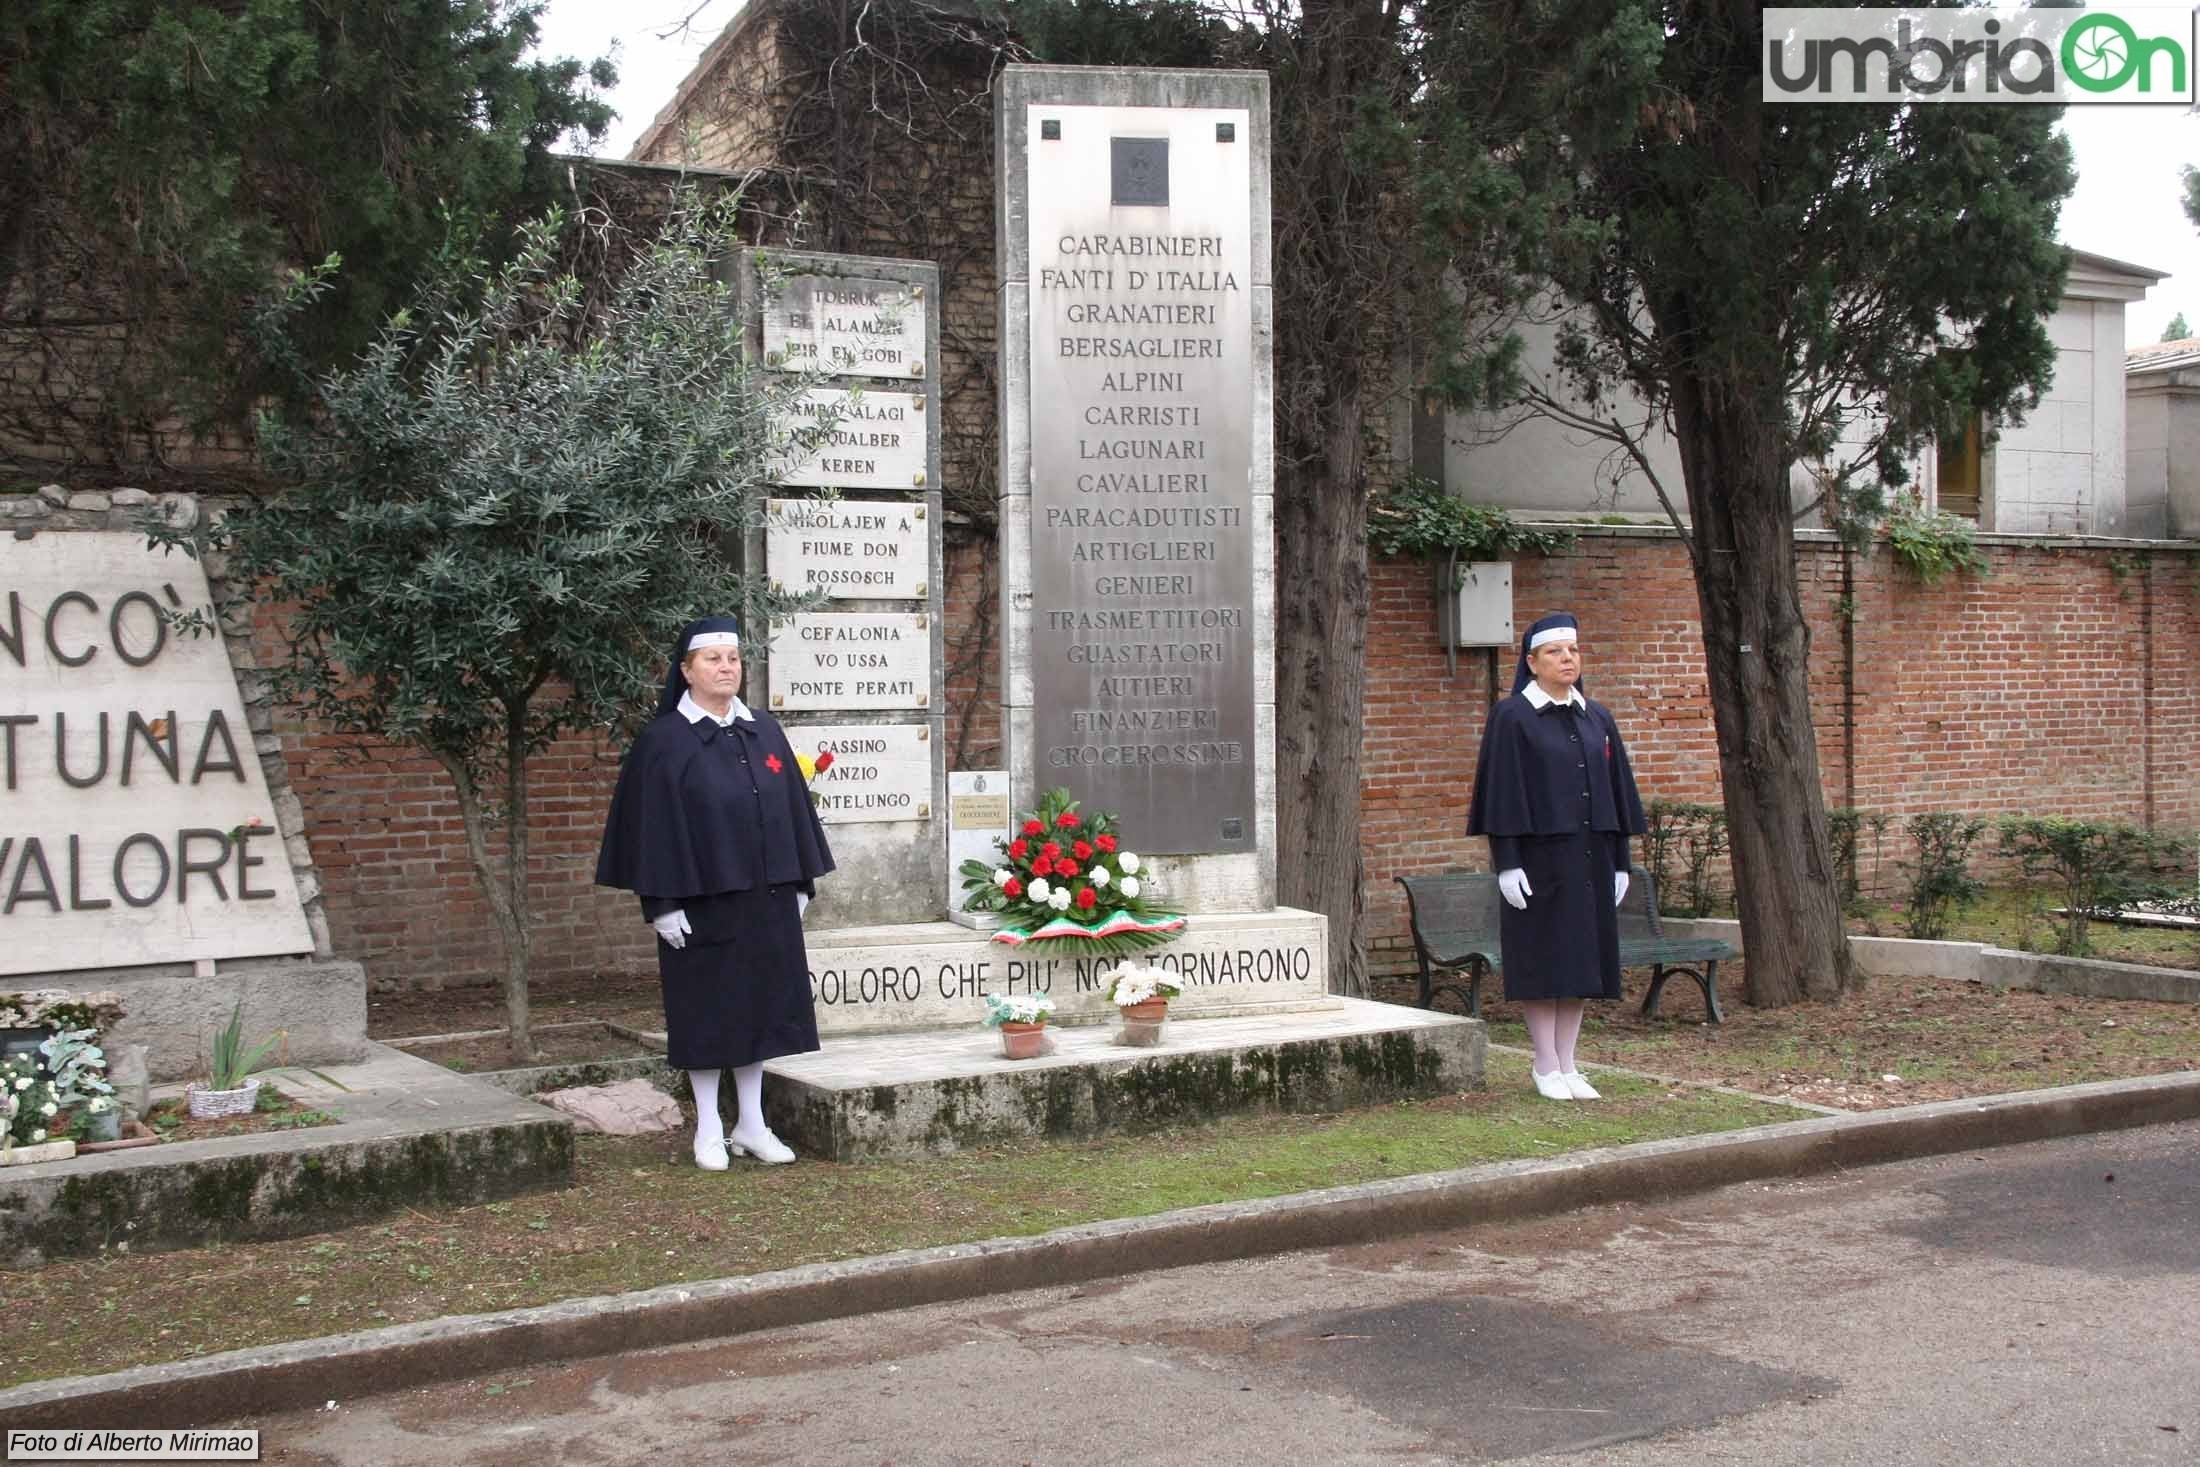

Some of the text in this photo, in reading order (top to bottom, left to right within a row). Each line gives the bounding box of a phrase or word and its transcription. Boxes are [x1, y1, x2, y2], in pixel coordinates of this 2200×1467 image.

[1059, 236, 1222, 256] CARABINIERI
[1041, 270, 1113, 289] FANTI
[815, 289, 879, 306] TOBRUK
[789, 313, 813, 329] EL
[1068, 304, 1216, 324] GRANATIERI
[863, 349, 903, 363] GOBI
[1060, 338, 1223, 358] BERSAGLIERI
[1101, 373, 1183, 392] ALPINI
[855, 406, 904, 420] ALAGI
[1084, 406, 1199, 426] CARRISTI
[796, 429, 900, 447] QUALBER
[1080, 440, 1205, 459] LAGUNARI
[822, 459, 874, 474] KEREN
[1077, 474, 1208, 493] CAVALIERI
[1047, 507, 1241, 527] PARACADUTISTI
[802, 542, 898, 557] FIUME DON
[1072, 542, 1216, 561] ARTIGLIERI
[807, 569, 895, 584] ROSSOSCH
[1095, 575, 1193, 595] GENIERI
[1048, 608, 1241, 630] TRASMETTITORI
[800, 627, 900, 641] CEFALONIA
[815, 654, 888, 667] VO USSA
[1067, 643, 1223, 664] GUASTATORI
[790, 681, 913, 696] PONTE PERATI
[1097, 677, 1192, 697] AUTIERI
[1072, 710, 1217, 732] FINANZIERI
[818, 740, 886, 753] CASSINO
[1049, 743, 1241, 767] CROCEROSSINE
[828, 767, 878, 781] ANZIO
[814, 793, 910, 809] NTELUNGO
[0, 826, 276, 914] ALORE
[939, 963, 990, 999] CHE
[1076, 955, 1129, 993] NO
